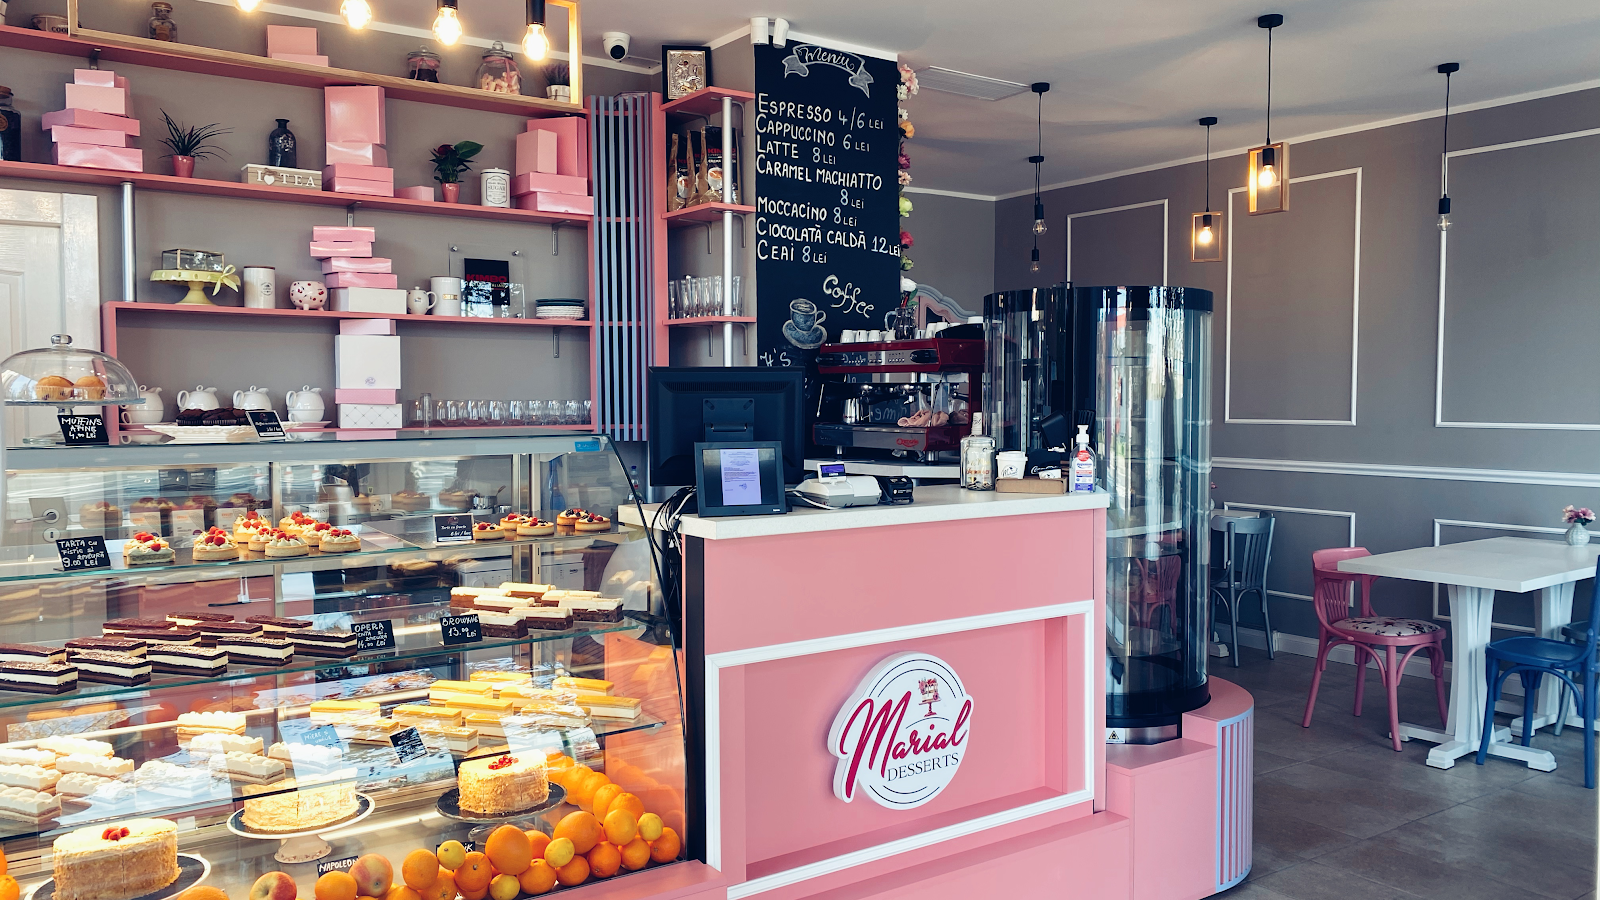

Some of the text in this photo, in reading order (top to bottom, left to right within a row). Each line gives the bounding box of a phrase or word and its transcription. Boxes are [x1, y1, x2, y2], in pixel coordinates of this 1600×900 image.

[798, 46, 855, 71] Meniu
[758, 93, 832, 122] ESPRESSO
[838, 106, 866, 131] 4/6
[756, 113, 870, 152] CAPPUCCINO 6 LEI
[757, 135, 836, 165] LATTE 8 LEI
[256, 170, 316, 187] I TEA
[756, 154, 882, 190] CARAMEL MACHIATTO
[840, 188, 849, 206] 8
[757, 196, 828, 221] MOCCACINO
[833, 207, 841, 224] 8
[757, 239, 794, 262] CEAI
[802, 245, 811, 262] 8
[871, 236, 889, 254] 12
[466, 274, 508, 283] KIMBO
[822, 274, 875, 319] Coffee
[58, 540, 85, 548] TARTA
[62, 557, 81, 568] 9.00
[354, 622, 384, 633] OPERA
[839, 691, 972, 799] Marial
[887, 752, 959, 782] DESSERTS
